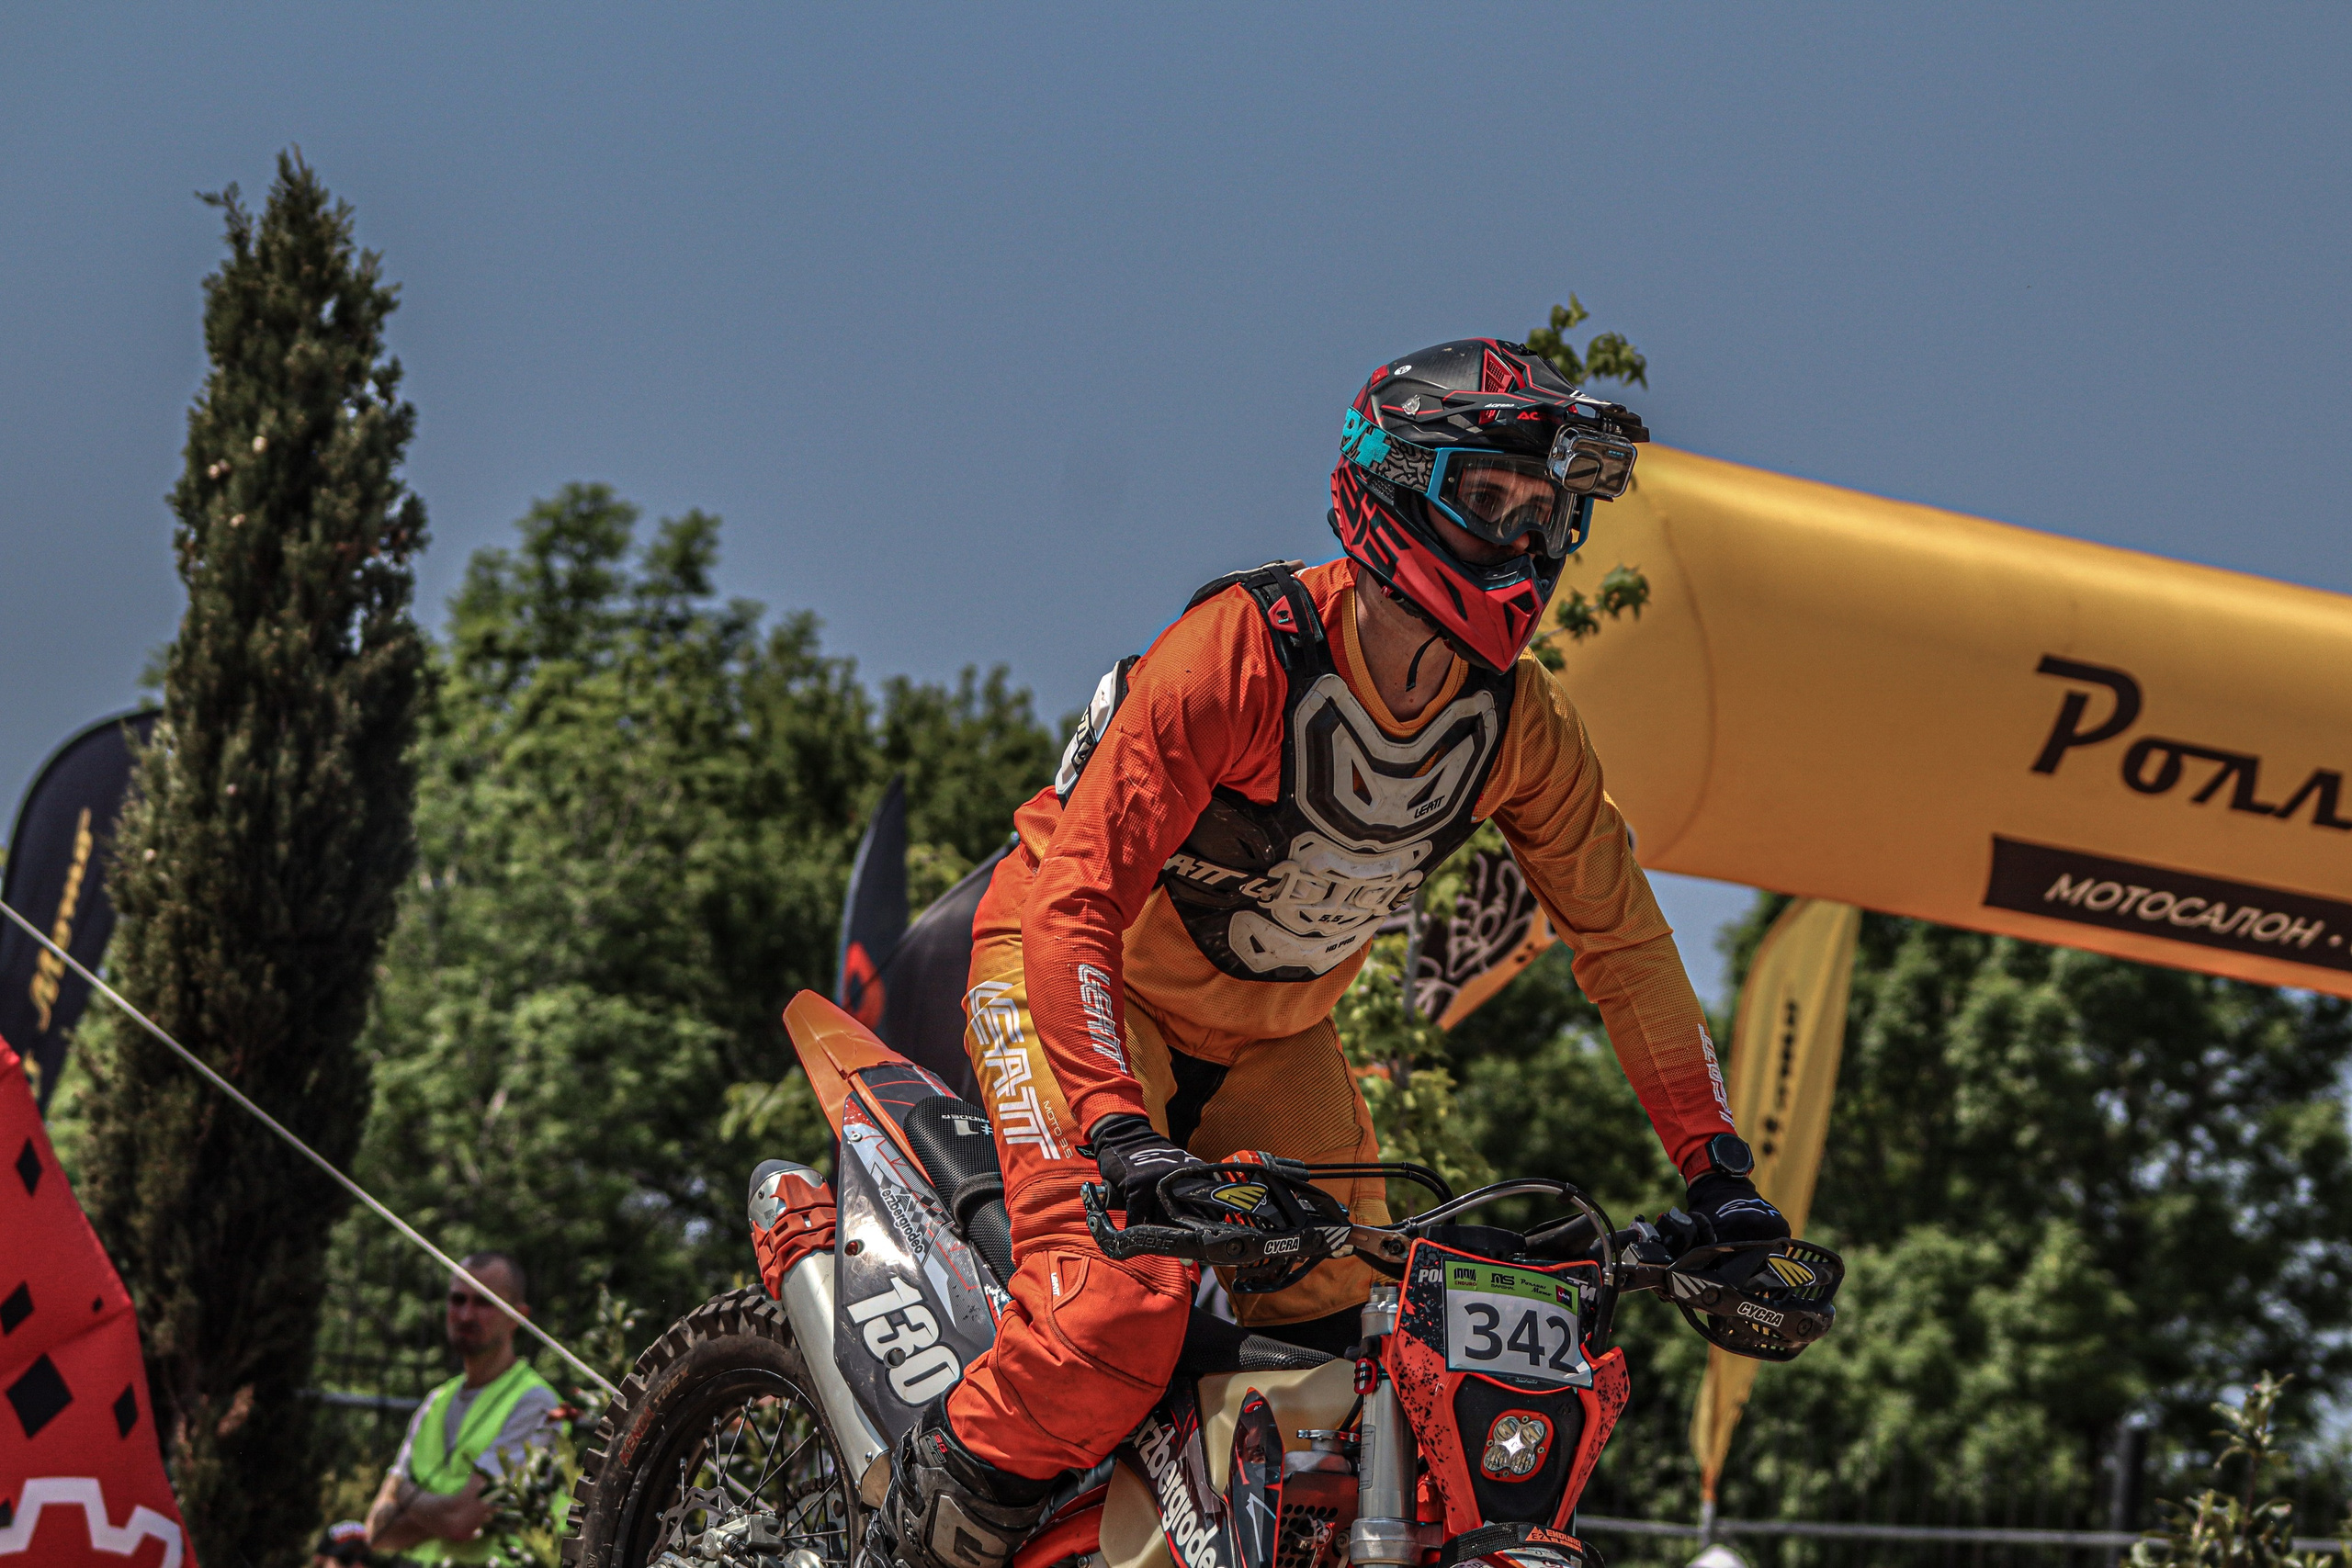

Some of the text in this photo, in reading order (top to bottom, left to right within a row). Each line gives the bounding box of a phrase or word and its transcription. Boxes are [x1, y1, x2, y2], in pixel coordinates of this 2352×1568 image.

[1413, 795, 1446, 819] LEATT
[1164, 852, 1249, 886] ATT
[2043, 873, 2326, 950] МОТОСАЛОН
[1078, 963, 1128, 1076] LEATT
[968, 979, 1061, 1161] LEATT
[1043, 1099, 1074, 1160] MOTO 3.5
[881, 1187, 926, 1255] erzbergrodeo
[1263, 1236, 1300, 1255] CYCRA
[846, 1275, 961, 1404] 130
[1464, 1302, 1579, 1373] 342
[1736, 1301, 1785, 1327] CYCRA
[617, 1405, 655, 1468] KENDA
